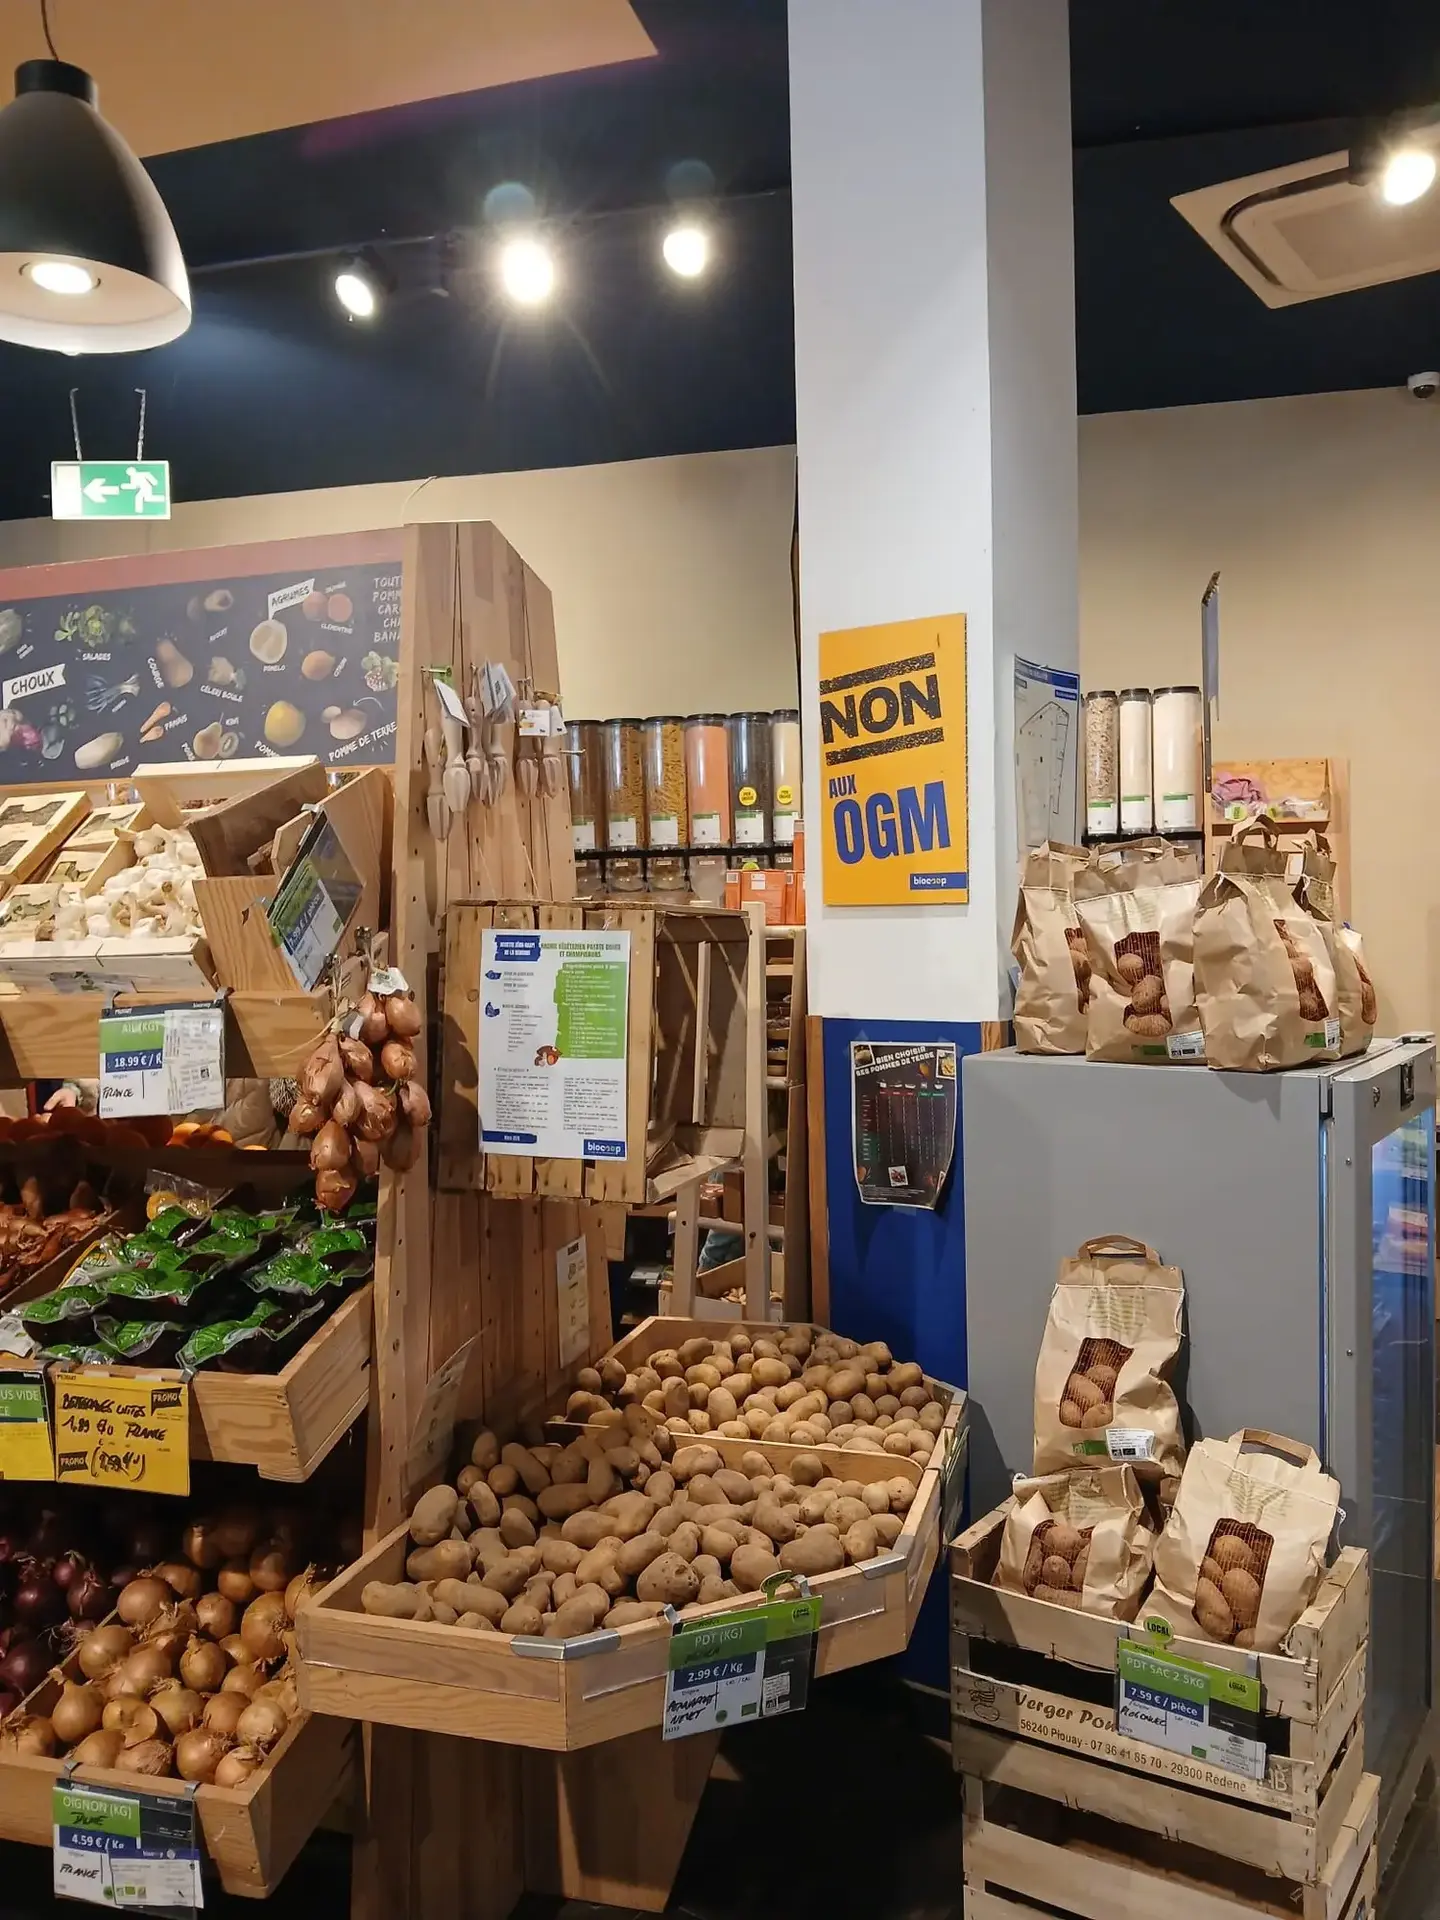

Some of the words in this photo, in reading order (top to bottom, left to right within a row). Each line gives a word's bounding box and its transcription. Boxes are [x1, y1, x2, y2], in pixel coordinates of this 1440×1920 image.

[271, 586, 310, 606] AGRUMES
[10, 670, 56, 696] CHOUX
[820, 673, 942, 744] NON
[328, 741, 358, 762] POMME
[358, 735, 371, 748] DE
[370, 720, 398, 743] TERRE
[829, 774, 857, 799] AUX
[833, 780, 951, 865] OGM
[913, 875, 947, 888] biocoop
[114, 1054, 139, 1068] 18.99
[140, 1054, 147, 1066] €
[148, 1053, 154, 1067] /
[855, 1067, 870, 1077] SES
[870, 1062, 900, 1074] POMMES
[901, 1057, 911, 1066] DE
[910, 1051, 935, 1063] TERRE
[875, 1053, 894, 1065] BIEN
[895, 1046, 926, 1059] CHOISIR
[102, 1086, 134, 1099] FRANCE
[587, 1141, 622, 1155] biocoop
[16, 1389, 40, 1400] VIDE
[152, 1392, 178, 1403] PROMO
[60, 1456, 85, 1466] PROMO
[695, 1630, 717, 1648] PDT
[719, 1627, 743, 1645] (KG)
[1146, 1622, 1170, 1635] LOCAL
[687, 1668, 711, 1683] 2.99
[713, 1666, 720, 1677] €
[721, 1663, 729, 1677] /
[730, 1662, 743, 1674] Kg
[1126, 1656, 1147, 1670] PDT
[1150, 1663, 1170, 1677] SAC
[1014, 1691, 1074, 1720] Verger
[1130, 1686, 1152, 1702] 7.59
[1154, 1694, 1162, 1705] €
[1163, 1697, 1169, 1708] /
[1170, 1700, 1198, 1717] pièce
[1020, 1718, 1049, 1736] 56240
[1090, 1739, 1103, 1752] 07
[1119, 1747, 1131, 1760] 41
[1134, 1752, 1147, 1765] 85
[1150, 1756, 1162, 1769] 70
[1170, 1762, 1203, 1780] 29300
[62, 1795, 108, 1814] OIGNON
[109, 1804, 132, 1820] (KG)
[71, 1833, 93, 1846] 4.59
[95, 1837, 103, 1848] €
[104, 1837, 110, 1850] /
[60, 1863, 100, 1880] FRANCE
